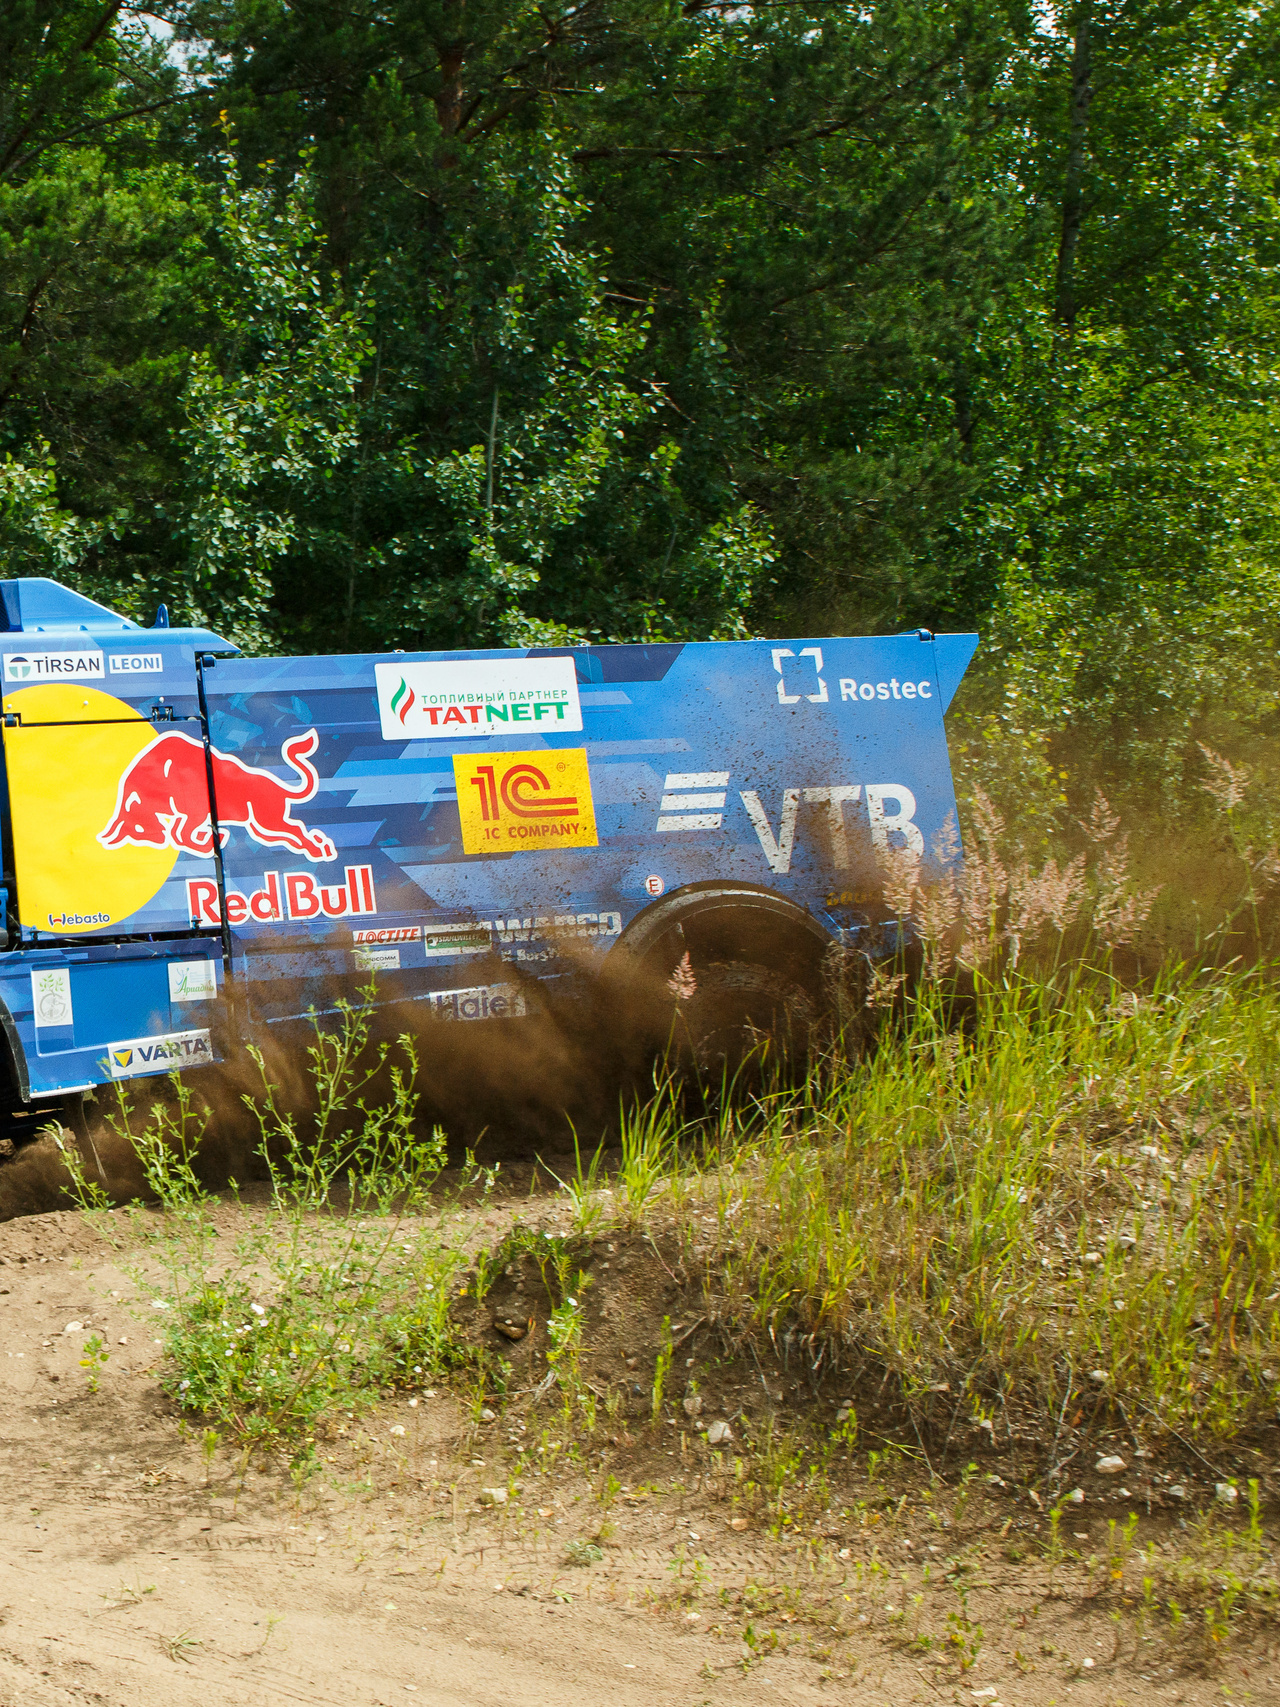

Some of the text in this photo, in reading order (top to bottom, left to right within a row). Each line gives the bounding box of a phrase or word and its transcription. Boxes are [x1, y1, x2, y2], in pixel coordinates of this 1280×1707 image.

[112, 657, 160, 670] LEONI
[421, 689, 568, 704] ТОПЛИВНЫЙ ПАРТНЕР
[839, 679, 933, 702] Rostec
[423, 702, 569, 726] TATNEFT
[508, 823, 580, 839] COMPANY
[739, 783, 925, 874] VTB
[649, 879, 659, 892] E
[186, 864, 377, 927] Red Bull
[49, 912, 110, 927] Webasto
[355, 929, 418, 945] LOCTITE
[138, 1038, 207, 1061] VARTA
